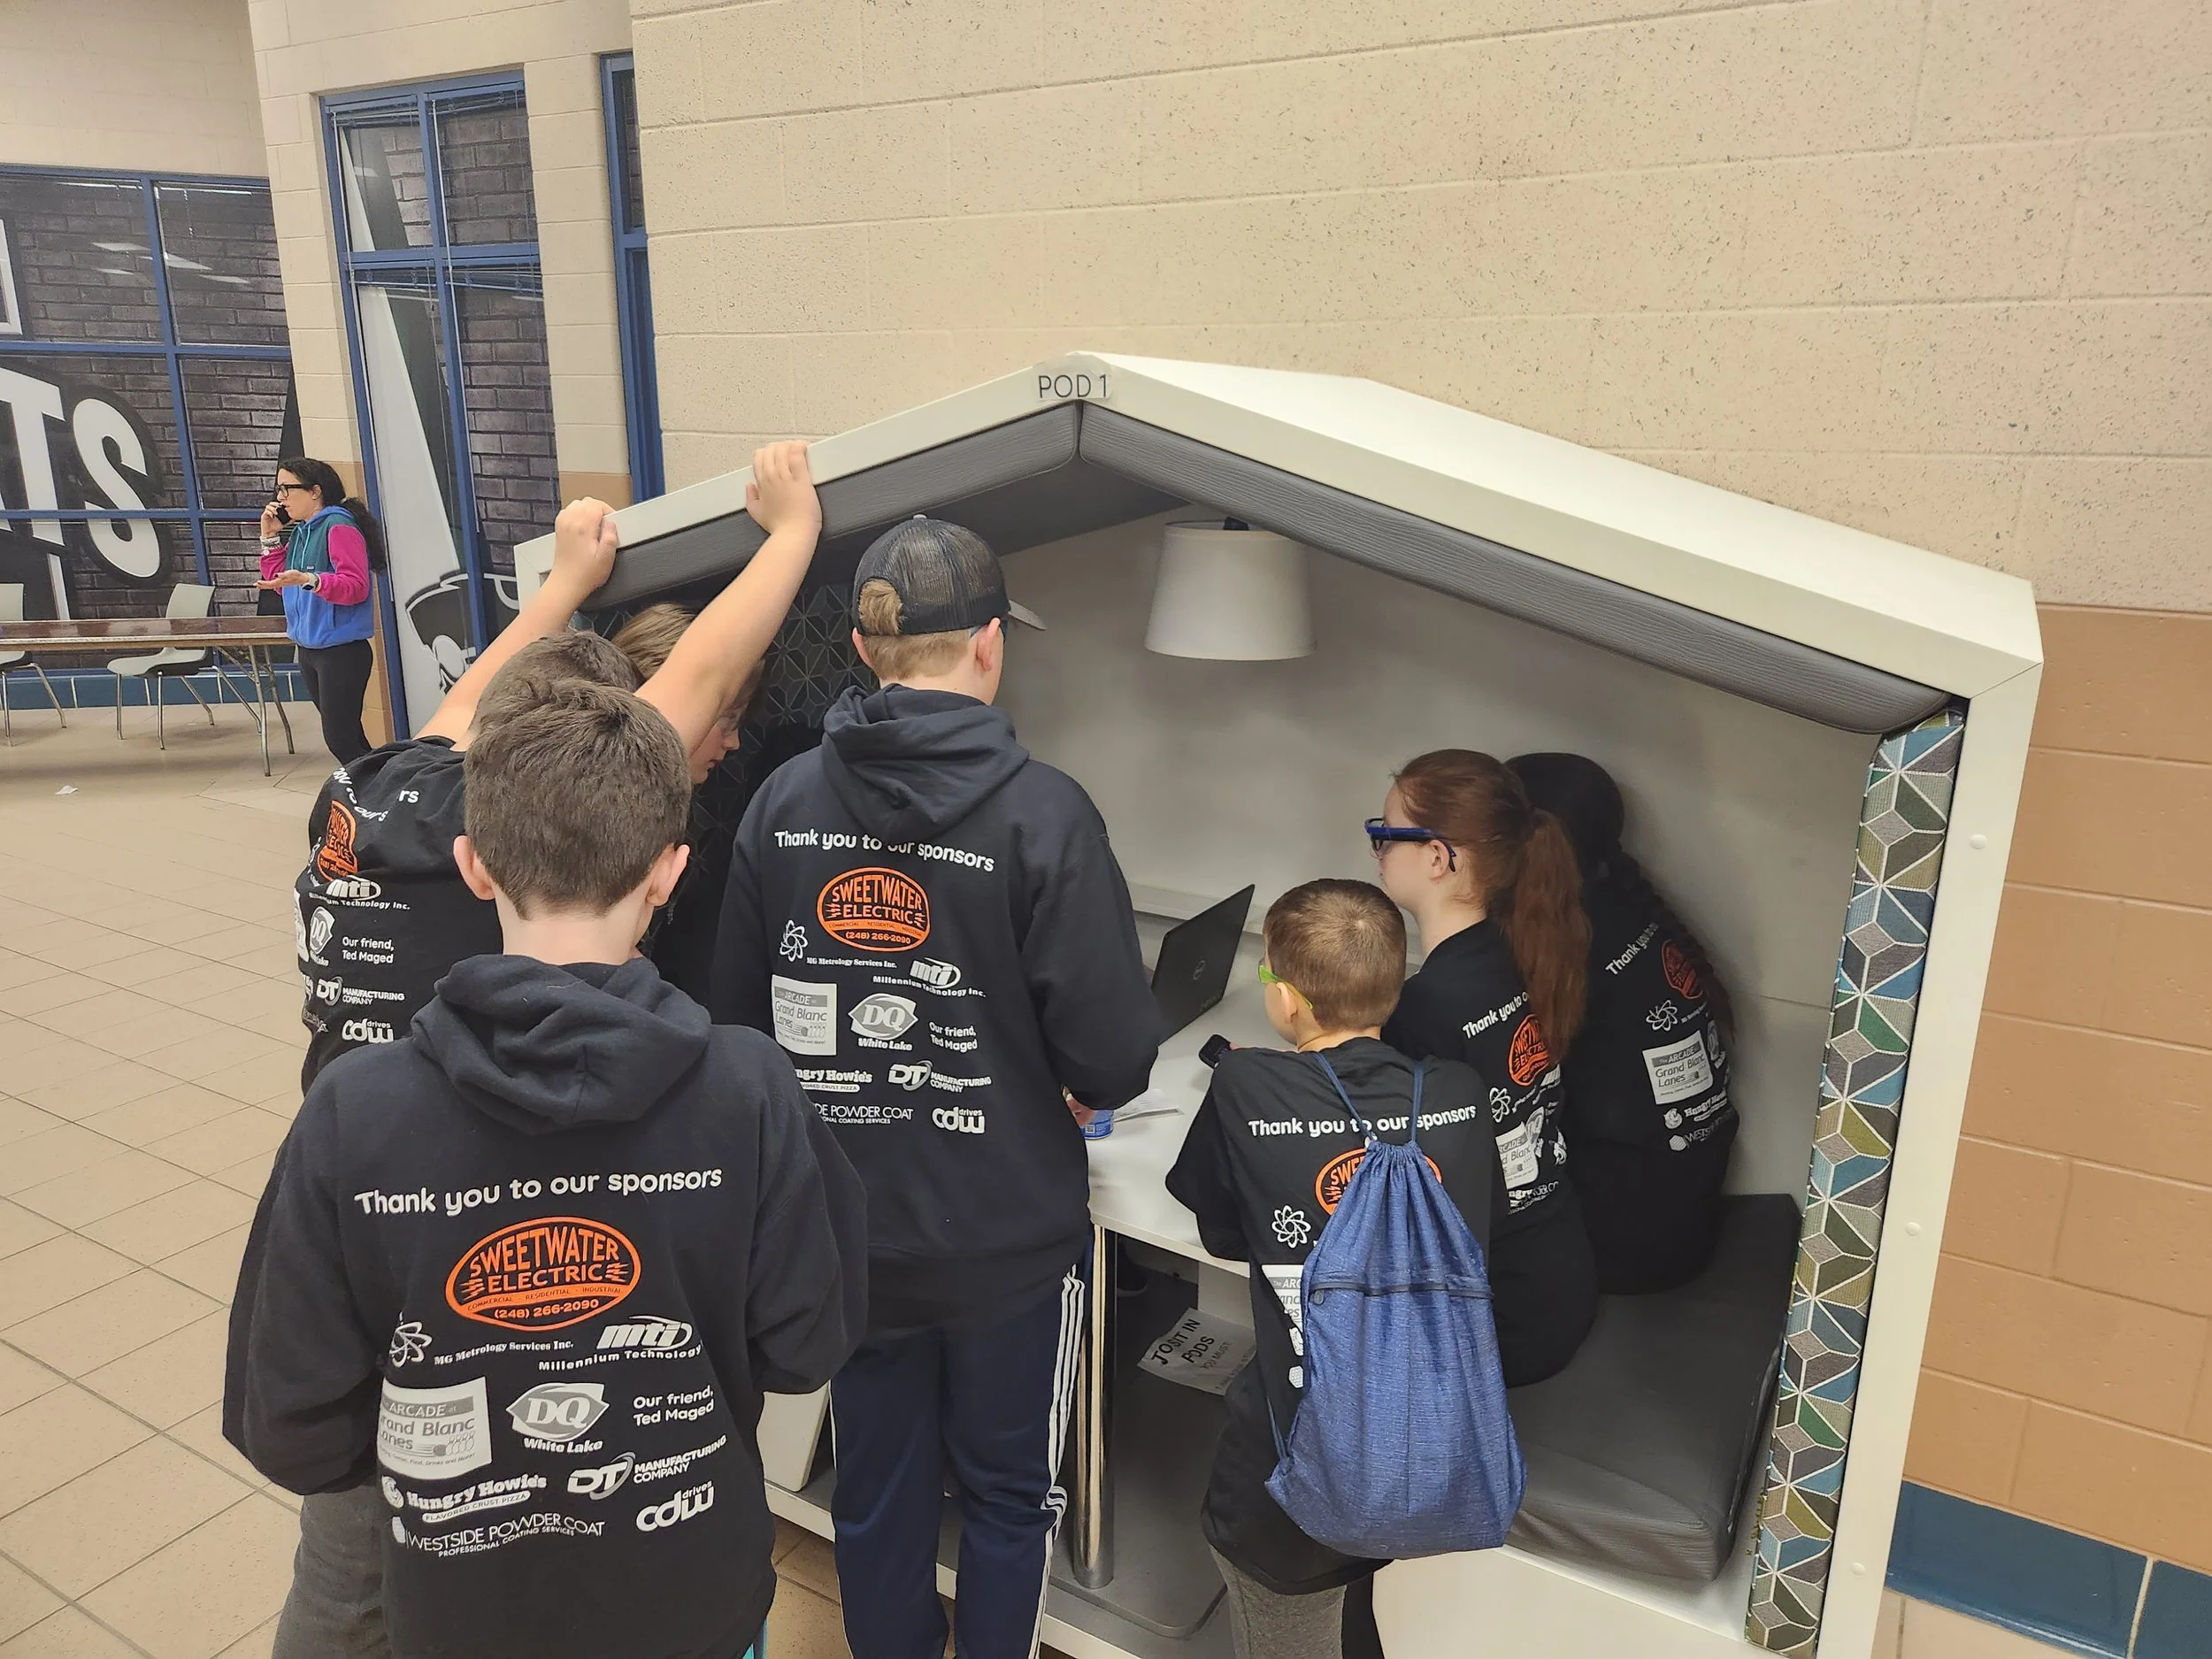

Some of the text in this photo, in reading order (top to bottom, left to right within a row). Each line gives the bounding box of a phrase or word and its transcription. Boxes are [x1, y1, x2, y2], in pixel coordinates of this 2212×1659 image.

[1039, 374, 1106, 398] POD 1
[774, 828, 818, 848] Thank
[822, 833, 856, 850] you
[862, 833, 882, 851] to
[918, 842, 995, 872] sponsors
[326, 879, 371, 898] mti
[832, 874, 922, 911] SWEETWATER
[341, 900, 390, 910] Technology
[843, 904, 917, 925] ELECTRIC
[342, 937, 395, 951] Our friend,
[872, 933, 911, 945] 266-2090
[342, 949, 394, 964] Ted Maged
[818, 957, 853, 966] Metrology
[854, 958, 883, 967] Services
[884, 959, 897, 969] Inc.
[1605, 943, 1640, 975] Thank
[910, 960, 954, 986] mti
[316, 979, 339, 1000] DT
[342, 987, 405, 1001] MANUFACTURING
[872, 976, 987, 997] Millennium Technology Inc.
[342, 995, 373, 1005] COMPANY
[784, 991, 811, 1005] ARCADE
[775, 1001, 827, 1022] Grand Blanc
[776, 1012, 793, 1028] Lanes
[863, 1003, 906, 1031] DQ
[1463, 1010, 1499, 1039] Thank
[1498, 1002, 1516, 1022] you
[1514, 995, 1522, 1008] to
[929, 1021, 977, 1037] Our friend,
[858, 1038, 913, 1051] White Lake
[930, 1033, 978, 1053] Ted Maged
[1669, 1047, 1695, 1064] ARCADE
[795, 1069, 872, 1083] ngry Howie's
[887, 1064, 928, 1085] DT
[931, 1071, 992, 1087] MANUFACTURING
[1655, 1064, 1685, 1079] Grand
[1659, 1073, 1686, 1087] Lanes
[930, 1079, 964, 1093] COMPANY
[831, 1105, 881, 1118] POWDER
[882, 1107, 914, 1120] COAT
[1248, 1105, 1477, 1138] Thank you to our sponsors
[354, 1168, 722, 1216] Thank you to our sponsors
[470, 1226, 619, 1278] SWEETWATER
[488, 1263, 603, 1294] ELECTRIC
[467, 1296, 513, 1310] COMMERCIAL
[525, 1288, 571, 1301] RESIDENTIAL
[494, 1299, 600, 1319] (248) 266-2090
[596, 1321, 681, 1349] mti
[1181, 1318, 1201, 1332] IN
[434, 1340, 574, 1365] MG Metrology Services Inc.
[538, 1345, 703, 1371] Millennium Technology
[1181, 1336, 1215, 1363] PODS
[1212, 1341, 1231, 1360] MUST
[634, 1385, 714, 1409] Our friend,
[389, 1402, 447, 1417] ARCADE
[525, 1396, 591, 1428] DQ
[634, 1399, 715, 1426] Ted Maged
[380, 1416, 475, 1436] rand Blanc
[380, 1431, 413, 1450] anes
[524, 1437, 603, 1453] White Lake
[634, 1434, 727, 1473] MANUFACTURING
[567, 1461, 628, 1494] DT
[634, 1463, 689, 1484] COMPANY
[407, 1474, 547, 1510] Hungry Howie's
[682, 1480, 712, 1499] drives
[425, 1494, 526, 1521] FLAVORED CRUST PIZZA
[408, 1513, 605, 1550] WESTSIDE POWDER COAT
[438, 1526, 575, 1557] PROFESSIONAL COATING SERVICES
